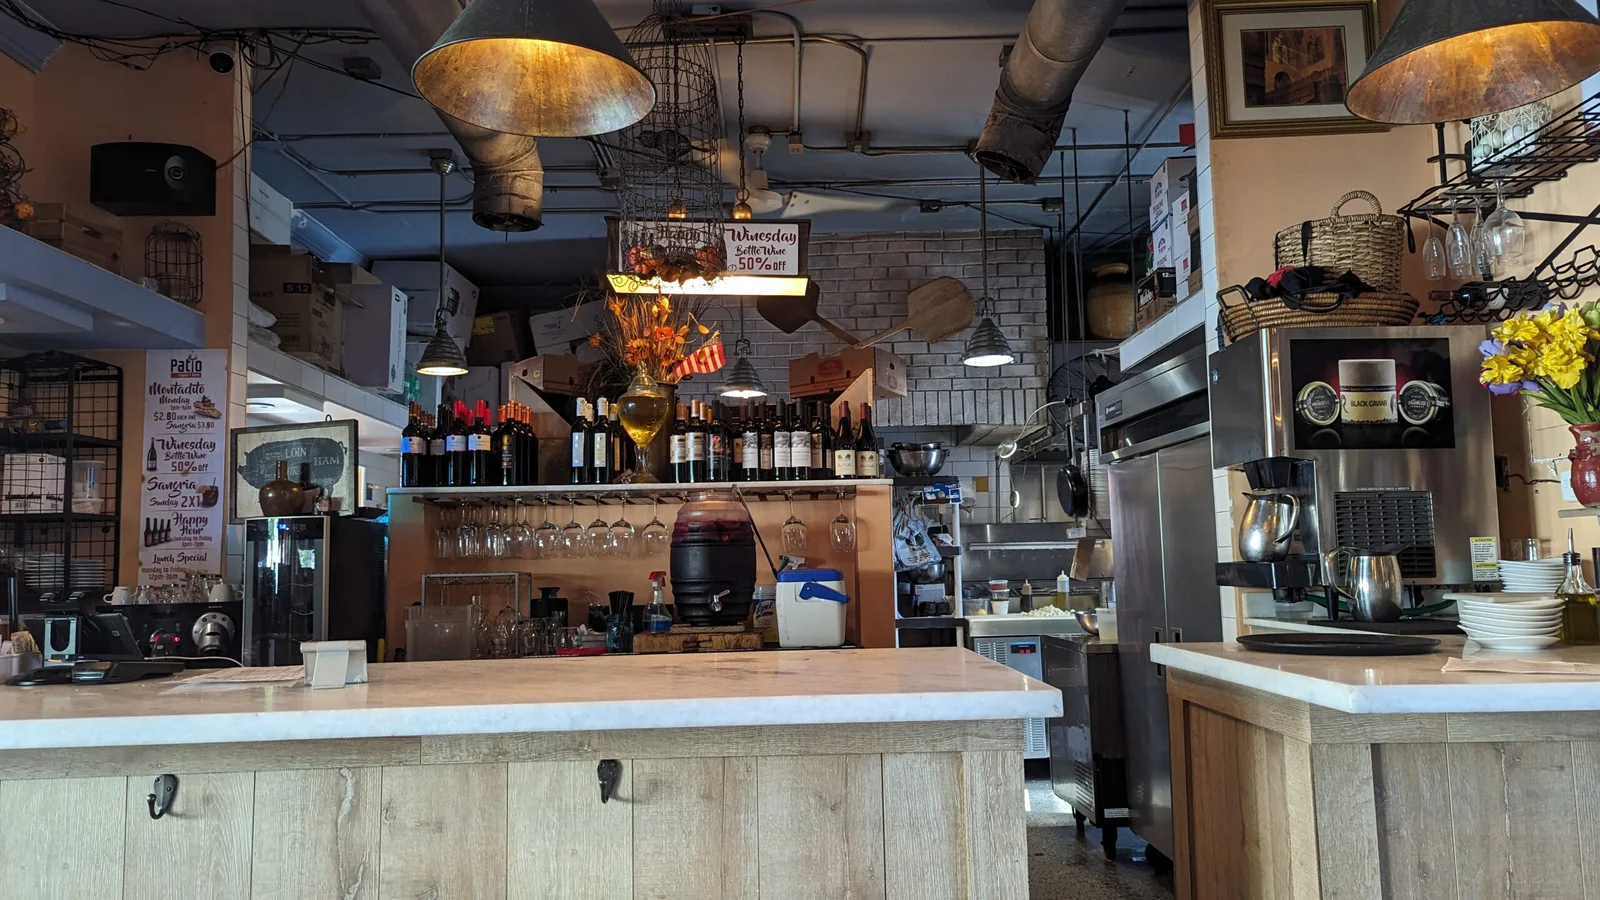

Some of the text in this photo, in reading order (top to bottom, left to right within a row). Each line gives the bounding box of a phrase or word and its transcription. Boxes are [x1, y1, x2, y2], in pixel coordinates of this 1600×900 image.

[725, 225, 796, 246] Winesday
[735, 244, 787, 257] Bottle Wine
[739, 257, 772, 270] 50%
[171, 359, 202, 373] Patio
[149, 381, 205, 396] Montadito
[159, 395, 190, 405] Monday
[166, 420, 196, 433] Sangria
[156, 436, 216, 452] Winesday
[164, 450, 206, 461] Bottle Wine
[285, 447, 307, 458] LOIN
[171, 461, 197, 472] 50%
[314, 456, 340, 465] HAM
[147, 476, 197, 498] Sangria
[149, 497, 179, 507] Sunday
[171, 511, 208, 527] Happy
[180, 525, 204, 536] Hour
[152, 552, 208, 565] Lunch Special
